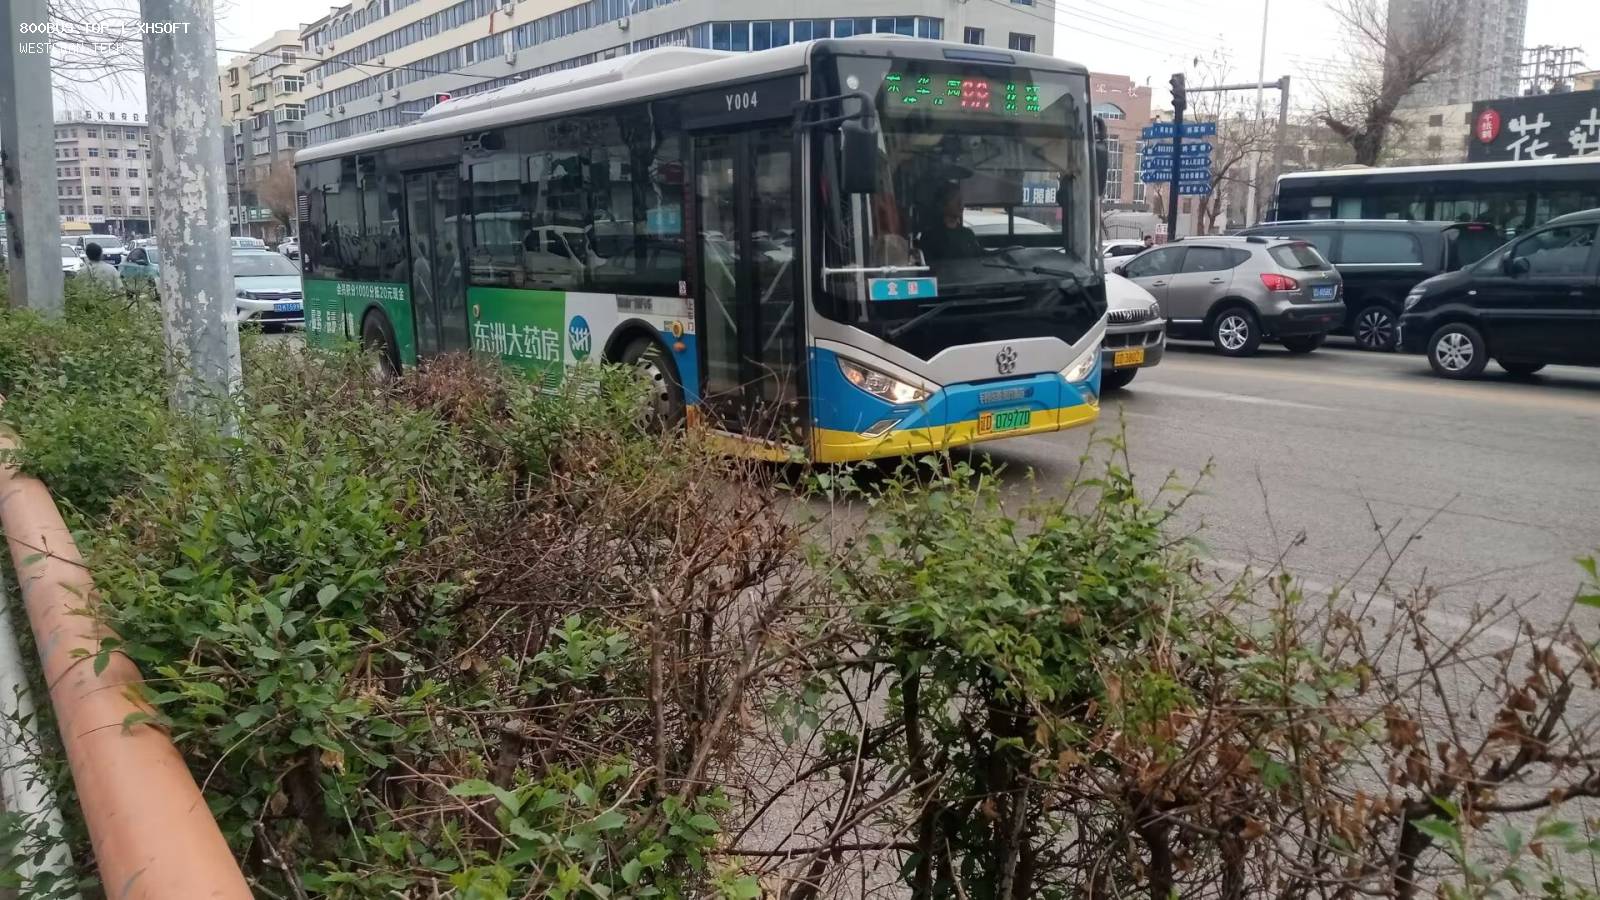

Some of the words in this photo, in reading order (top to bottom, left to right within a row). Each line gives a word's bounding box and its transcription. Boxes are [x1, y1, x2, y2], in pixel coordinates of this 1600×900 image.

[725, 90, 759, 112] Y004
[473, 319, 560, 362] 东洲大药房
